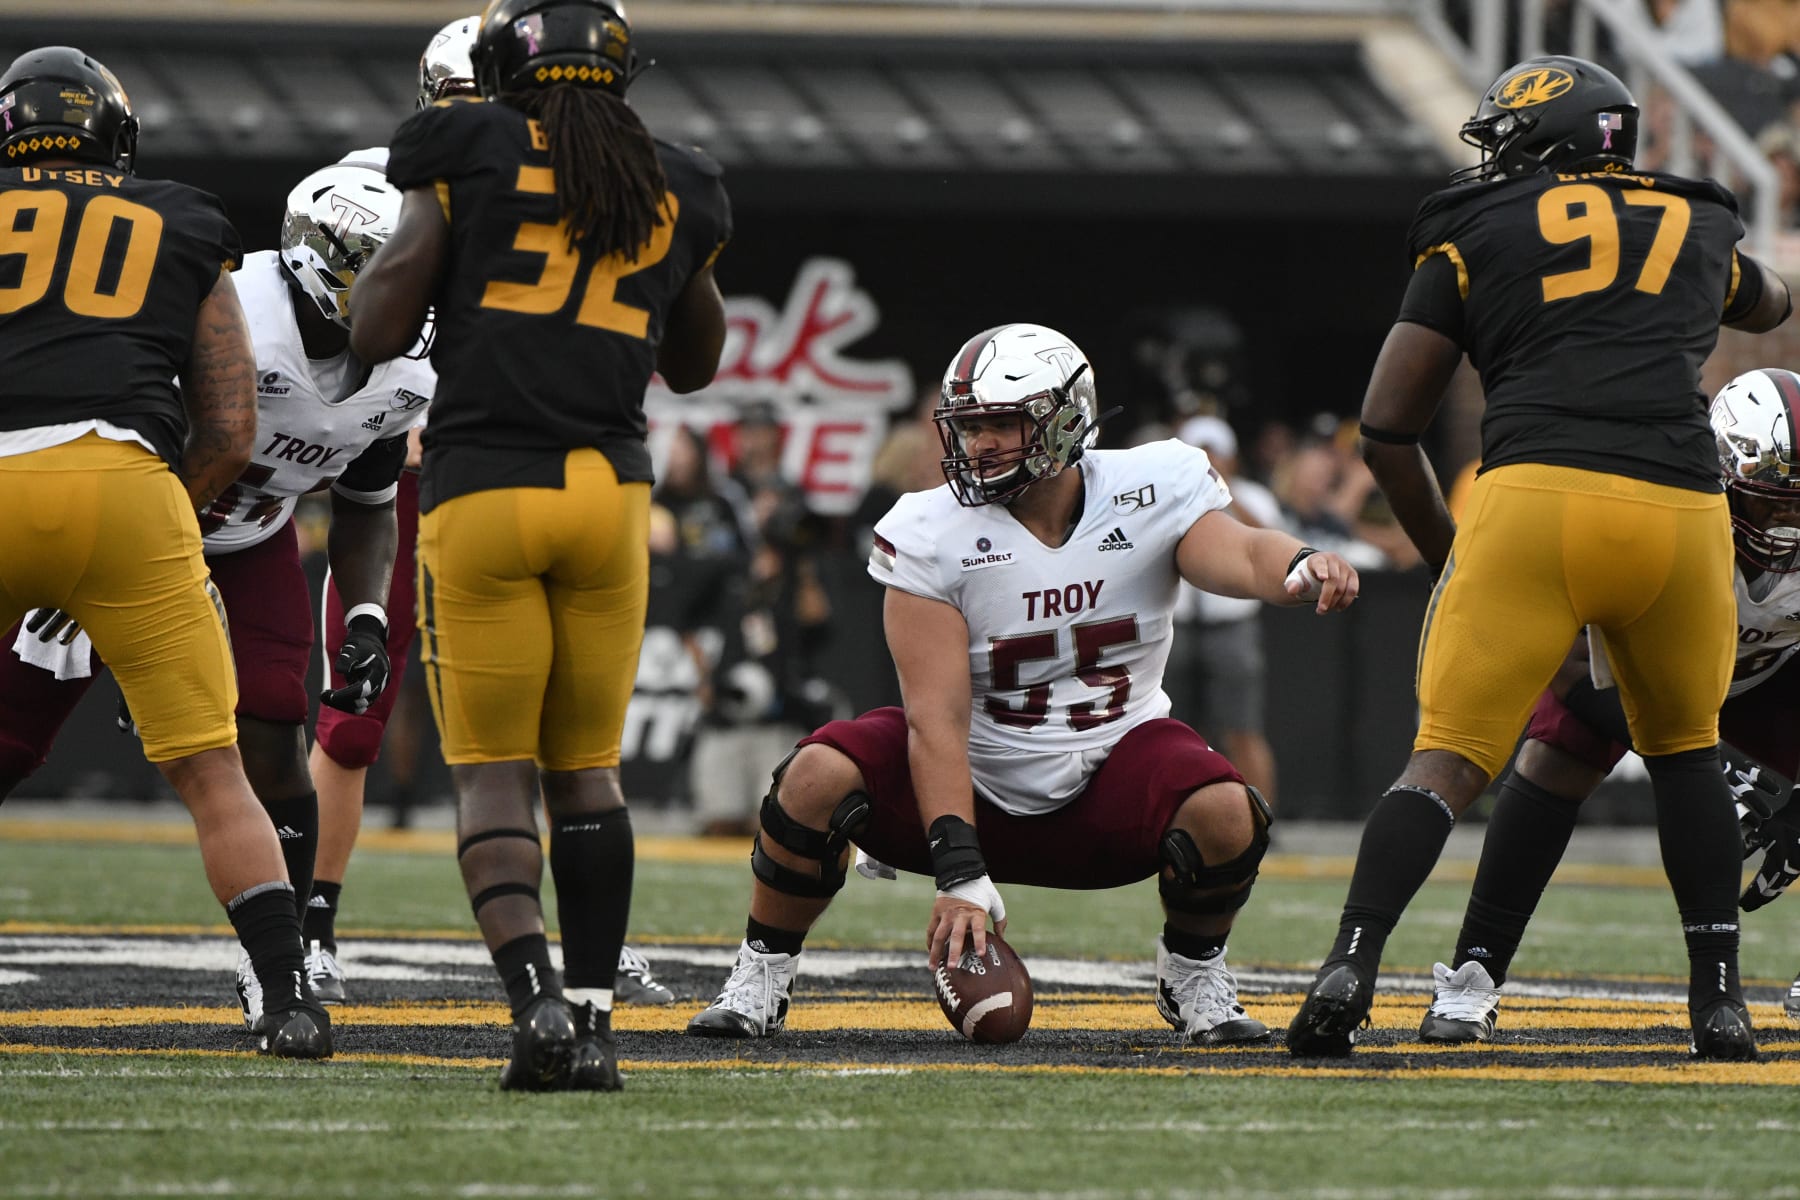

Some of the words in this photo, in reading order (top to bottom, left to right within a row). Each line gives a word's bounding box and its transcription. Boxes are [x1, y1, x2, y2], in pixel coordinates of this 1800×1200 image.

[0, 190, 163, 319] 90
[480, 166, 679, 339] 32
[1537, 184, 1691, 303] 97
[266, 386, 290, 395] BELT
[262, 432, 342, 467] TROY
[1113, 484, 1156, 515] 150
[962, 556, 986, 568] SUN
[987, 553, 1013, 564] BELT
[1098, 540, 1134, 551] adidas
[1022, 579, 1104, 621] TROY
[983, 613, 1141, 735] 55
